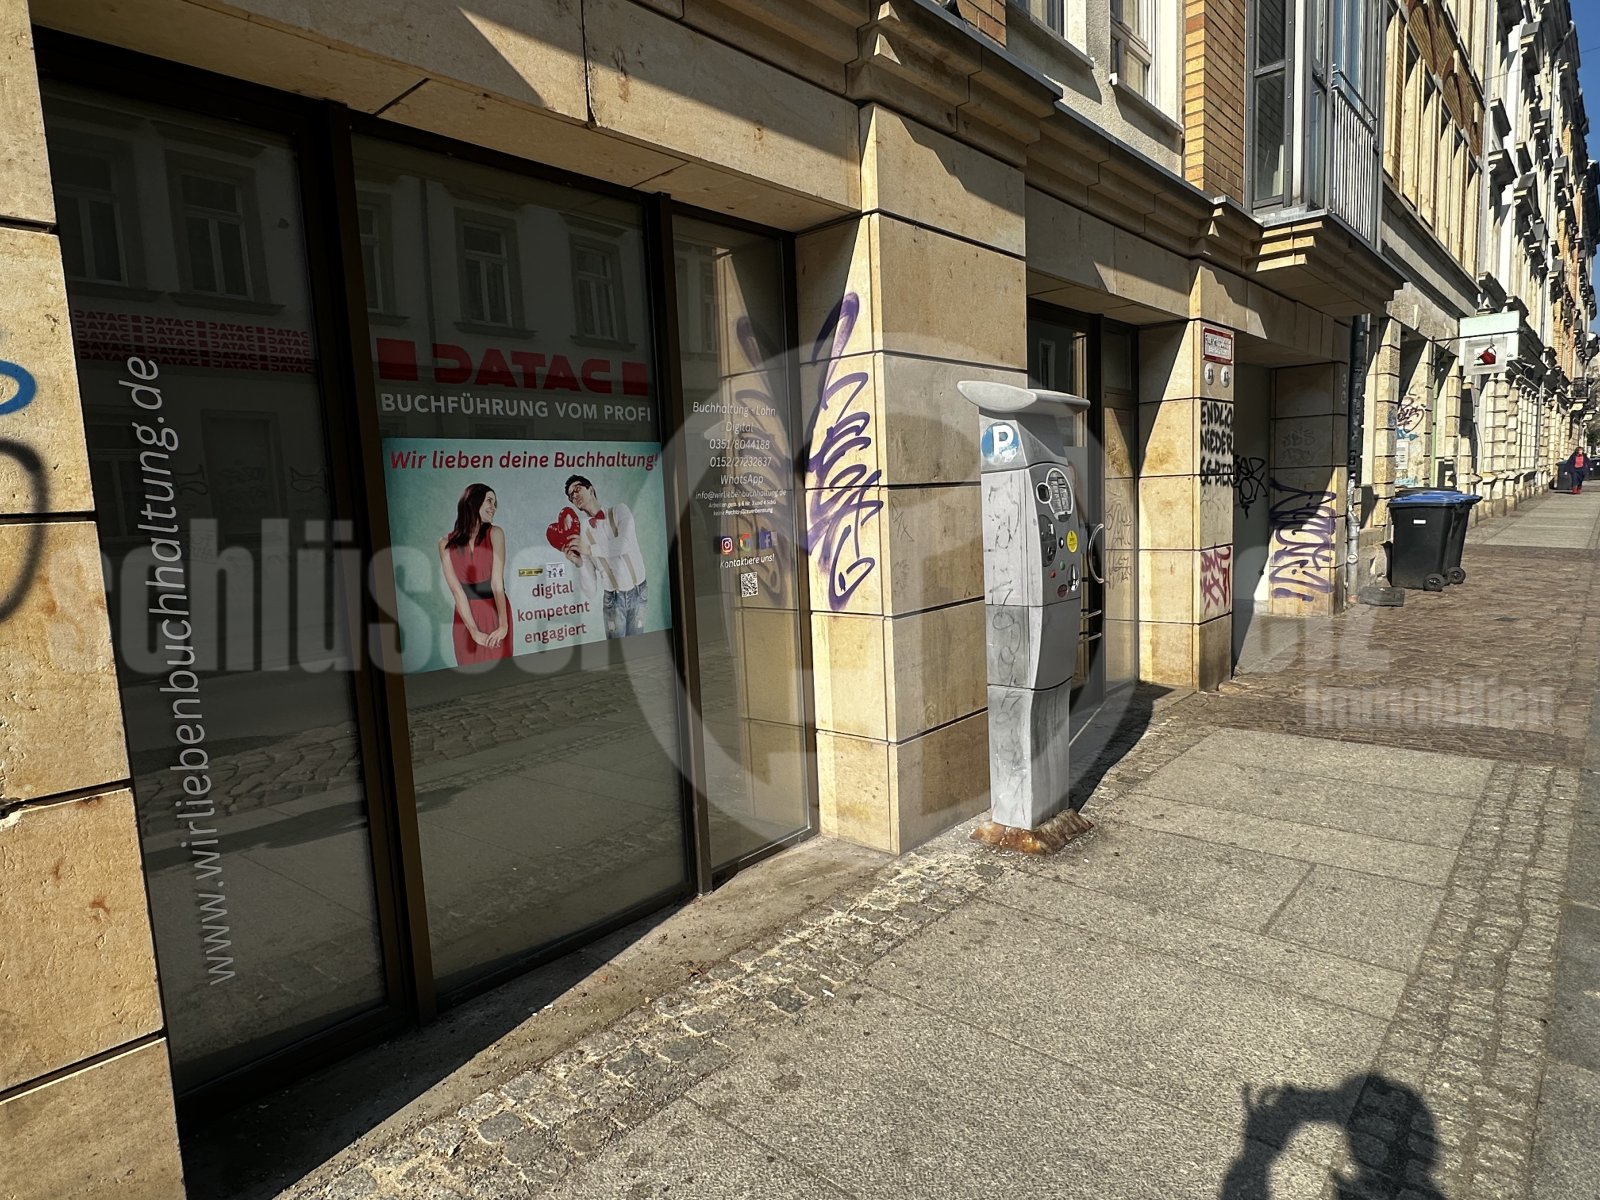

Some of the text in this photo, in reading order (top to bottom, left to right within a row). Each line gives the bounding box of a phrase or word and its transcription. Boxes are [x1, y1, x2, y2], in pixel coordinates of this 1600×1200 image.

[74, 310, 309, 338] DATAC DATAC DATAC DATAC
[76, 321, 310, 347] DATAC DATAC DATAC DATAC
[77, 330, 310, 356] DATAC DATAC DATAC DATAC
[79, 340, 312, 366] DATAC DATAC DATAC DATAC
[214, 360, 258, 371] DATAC
[272, 365, 312, 374] DATAC
[432, 343, 612, 394] DATAC
[380, 392, 651, 422] BUCHFÜHRUNG VOM PROFI
[692, 401, 749, 418] Buchhaltung
[756, 405, 776, 416] Lohn
[725, 421, 754, 435] Digital
[993, 424, 1014, 452] P
[709, 438, 770, 450] 0351/8044188
[390, 450, 659, 472] Wir lieben deine Buchhaltung!
[720, 474, 764, 486] WhatsApp
[719, 553, 775, 569] Kontaktiere uns!
[531, 580, 574, 599] digital
[517, 601, 590, 622] kompetent
[524, 623, 587, 644] engagiert
[118, 356, 236, 985] www.wirliebenbuchhaltung.de
